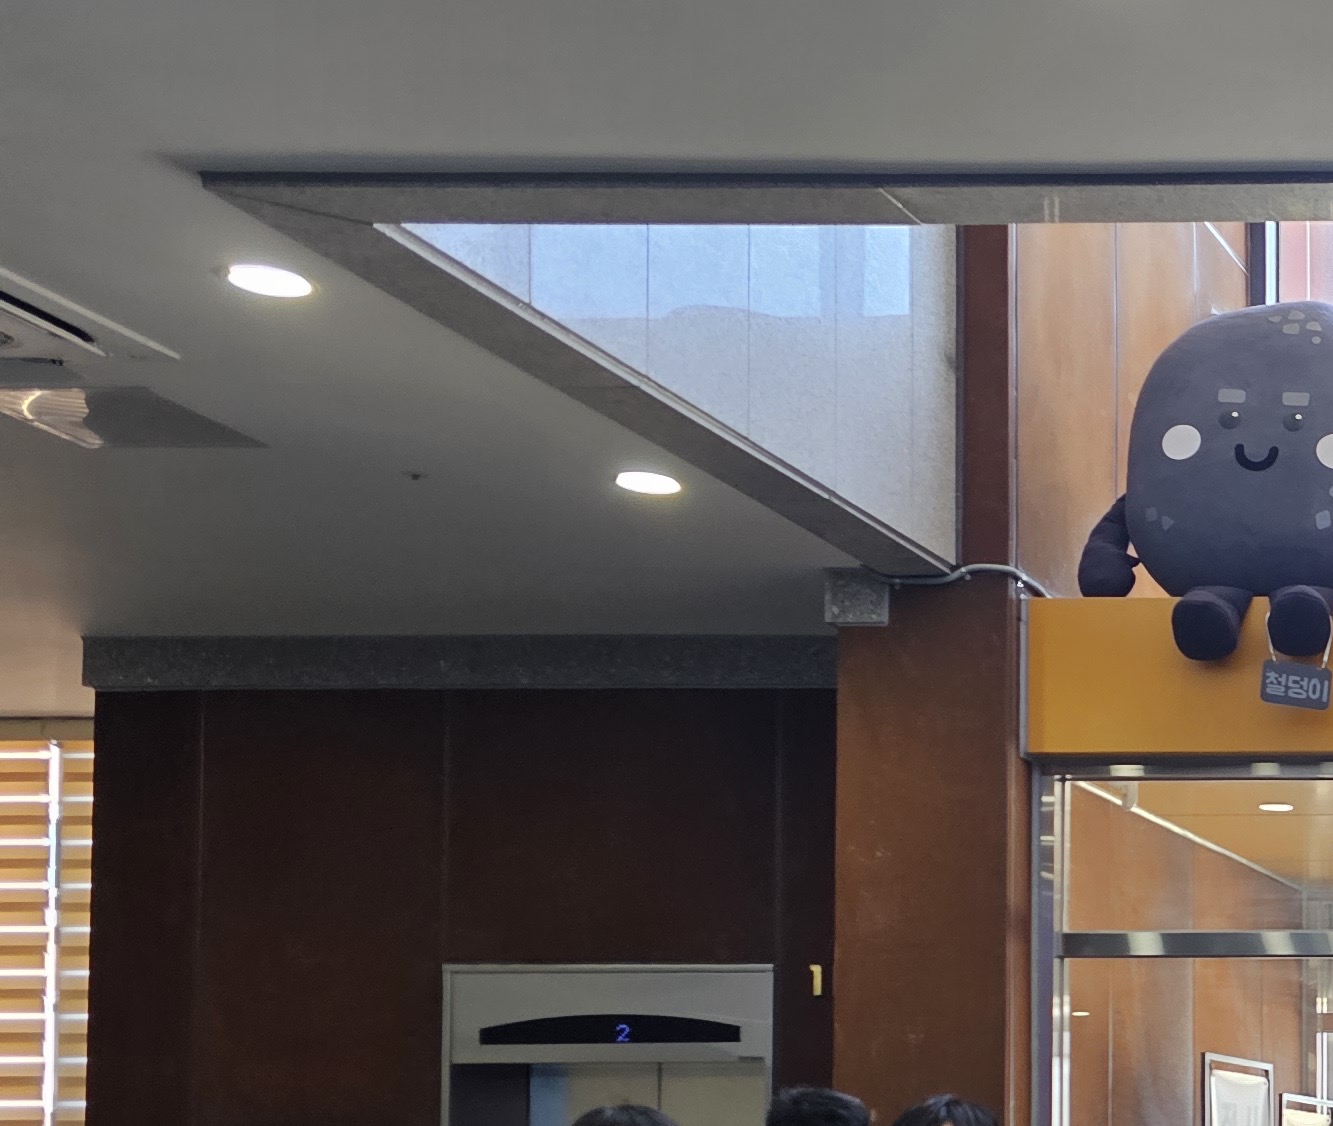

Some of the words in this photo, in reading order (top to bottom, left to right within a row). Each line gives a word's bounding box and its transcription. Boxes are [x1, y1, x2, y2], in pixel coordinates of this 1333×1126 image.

[1265, 671, 1329, 702] 철덩이
[809, 964, 822, 996] 1
[615, 1023, 631, 1042] 2
